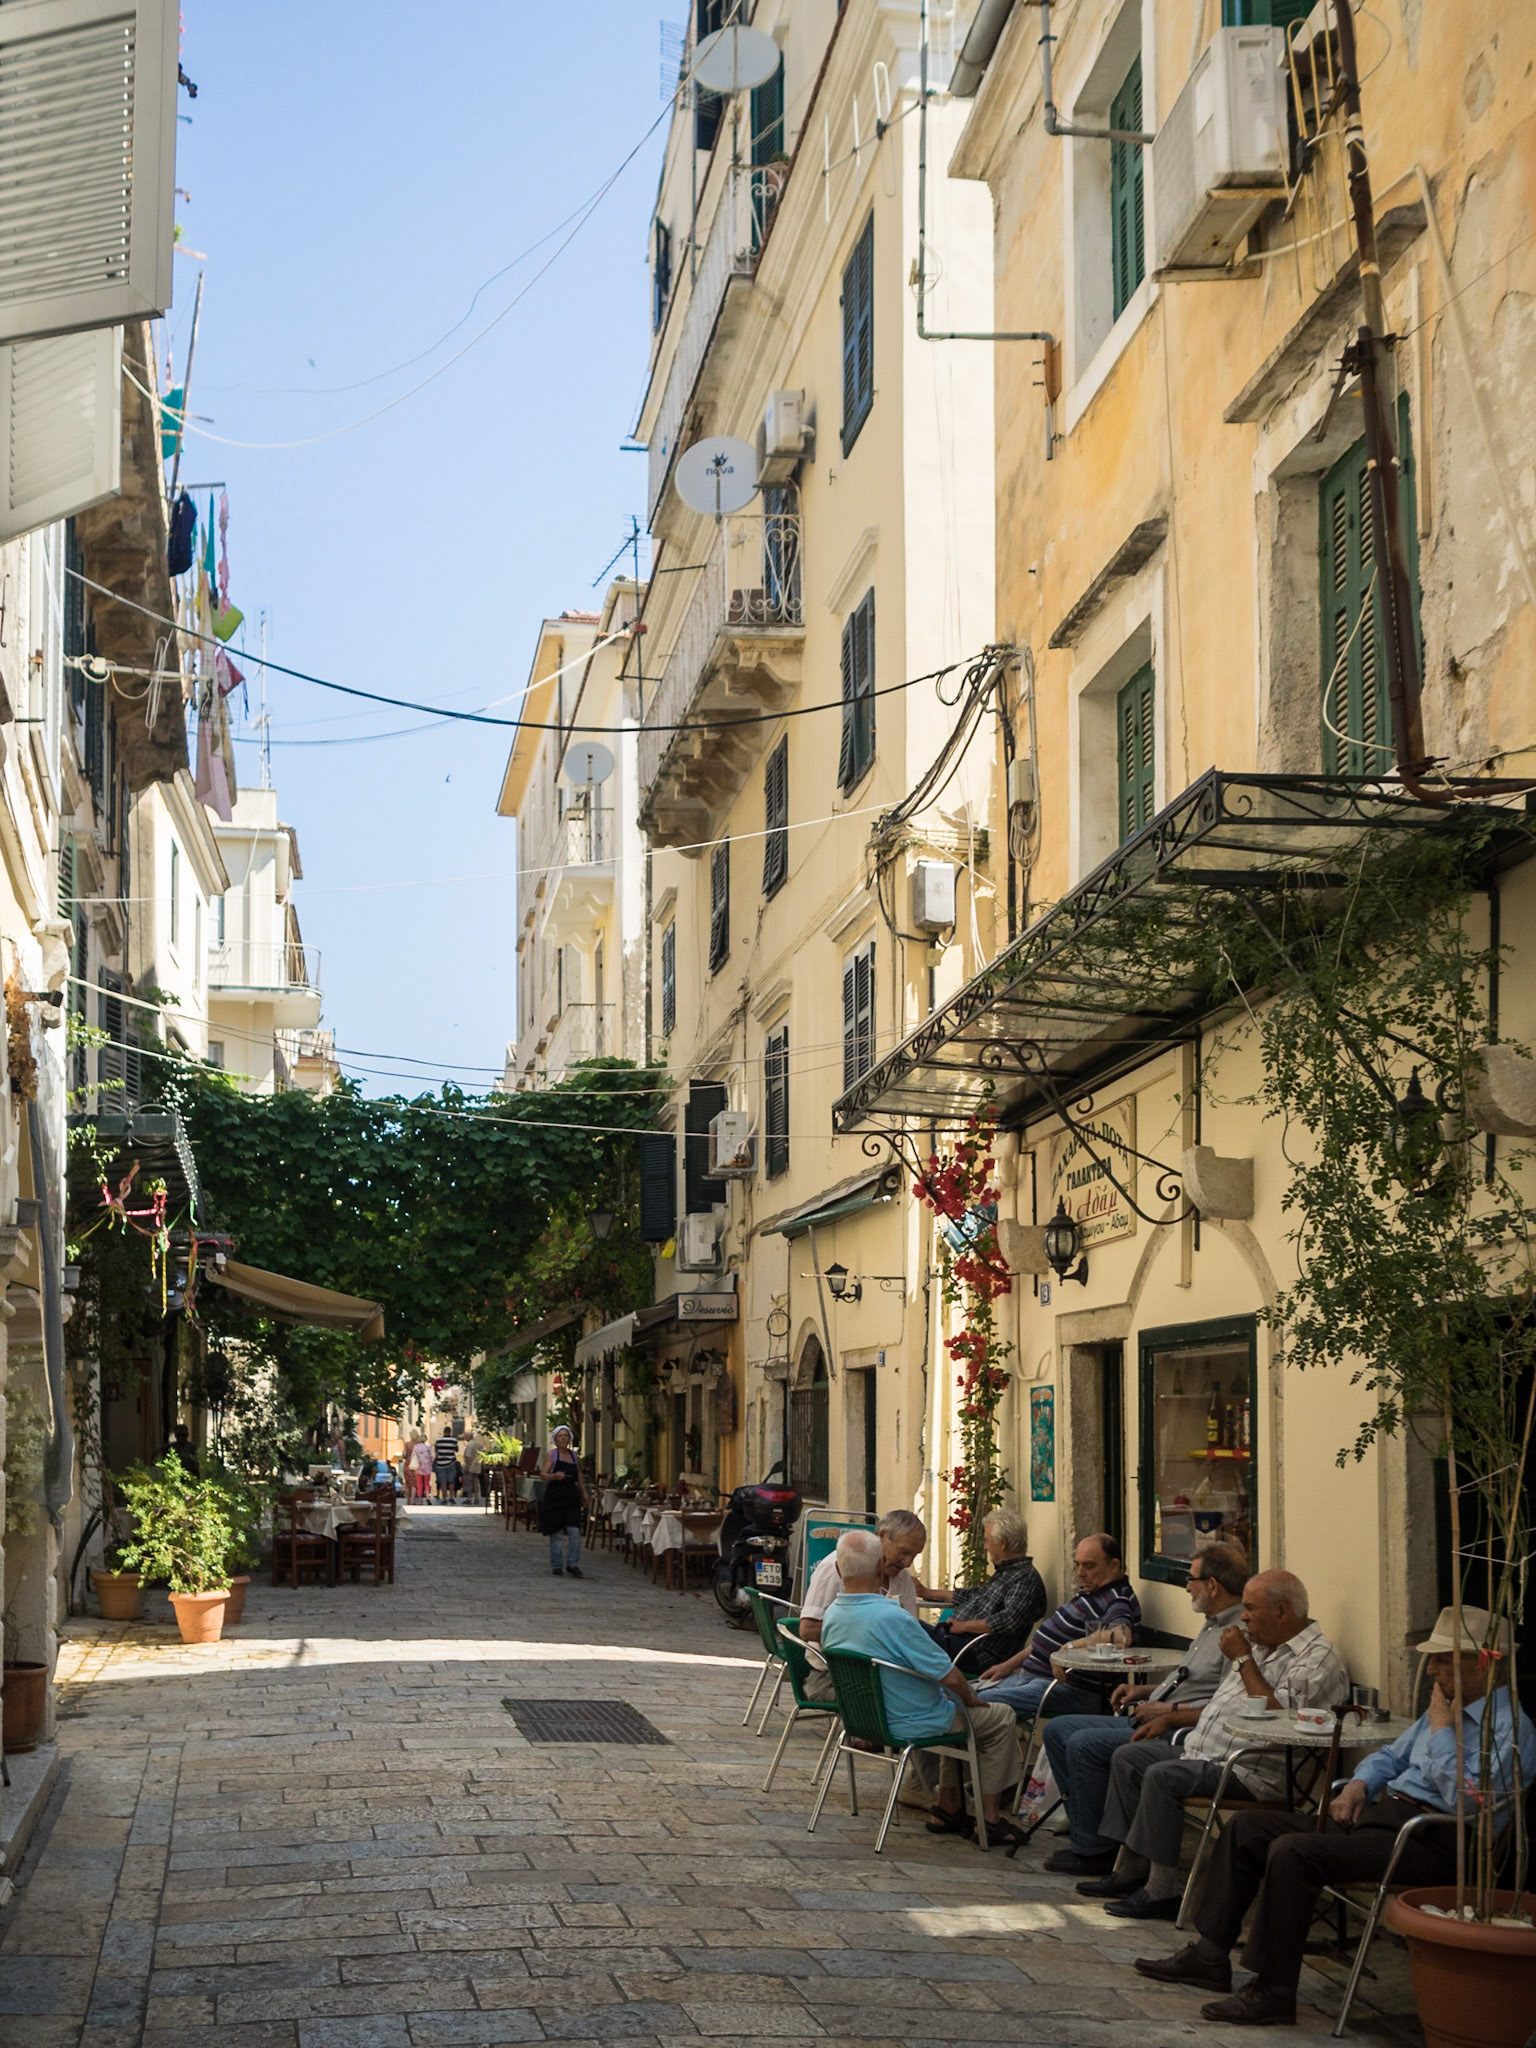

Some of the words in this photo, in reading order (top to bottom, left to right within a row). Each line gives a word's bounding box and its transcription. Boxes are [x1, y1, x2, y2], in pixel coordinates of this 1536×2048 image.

[705, 466, 735, 475] nova
[682, 1299, 735, 1314] Vesuvio
[763, 1575, 781, 1584] 139
